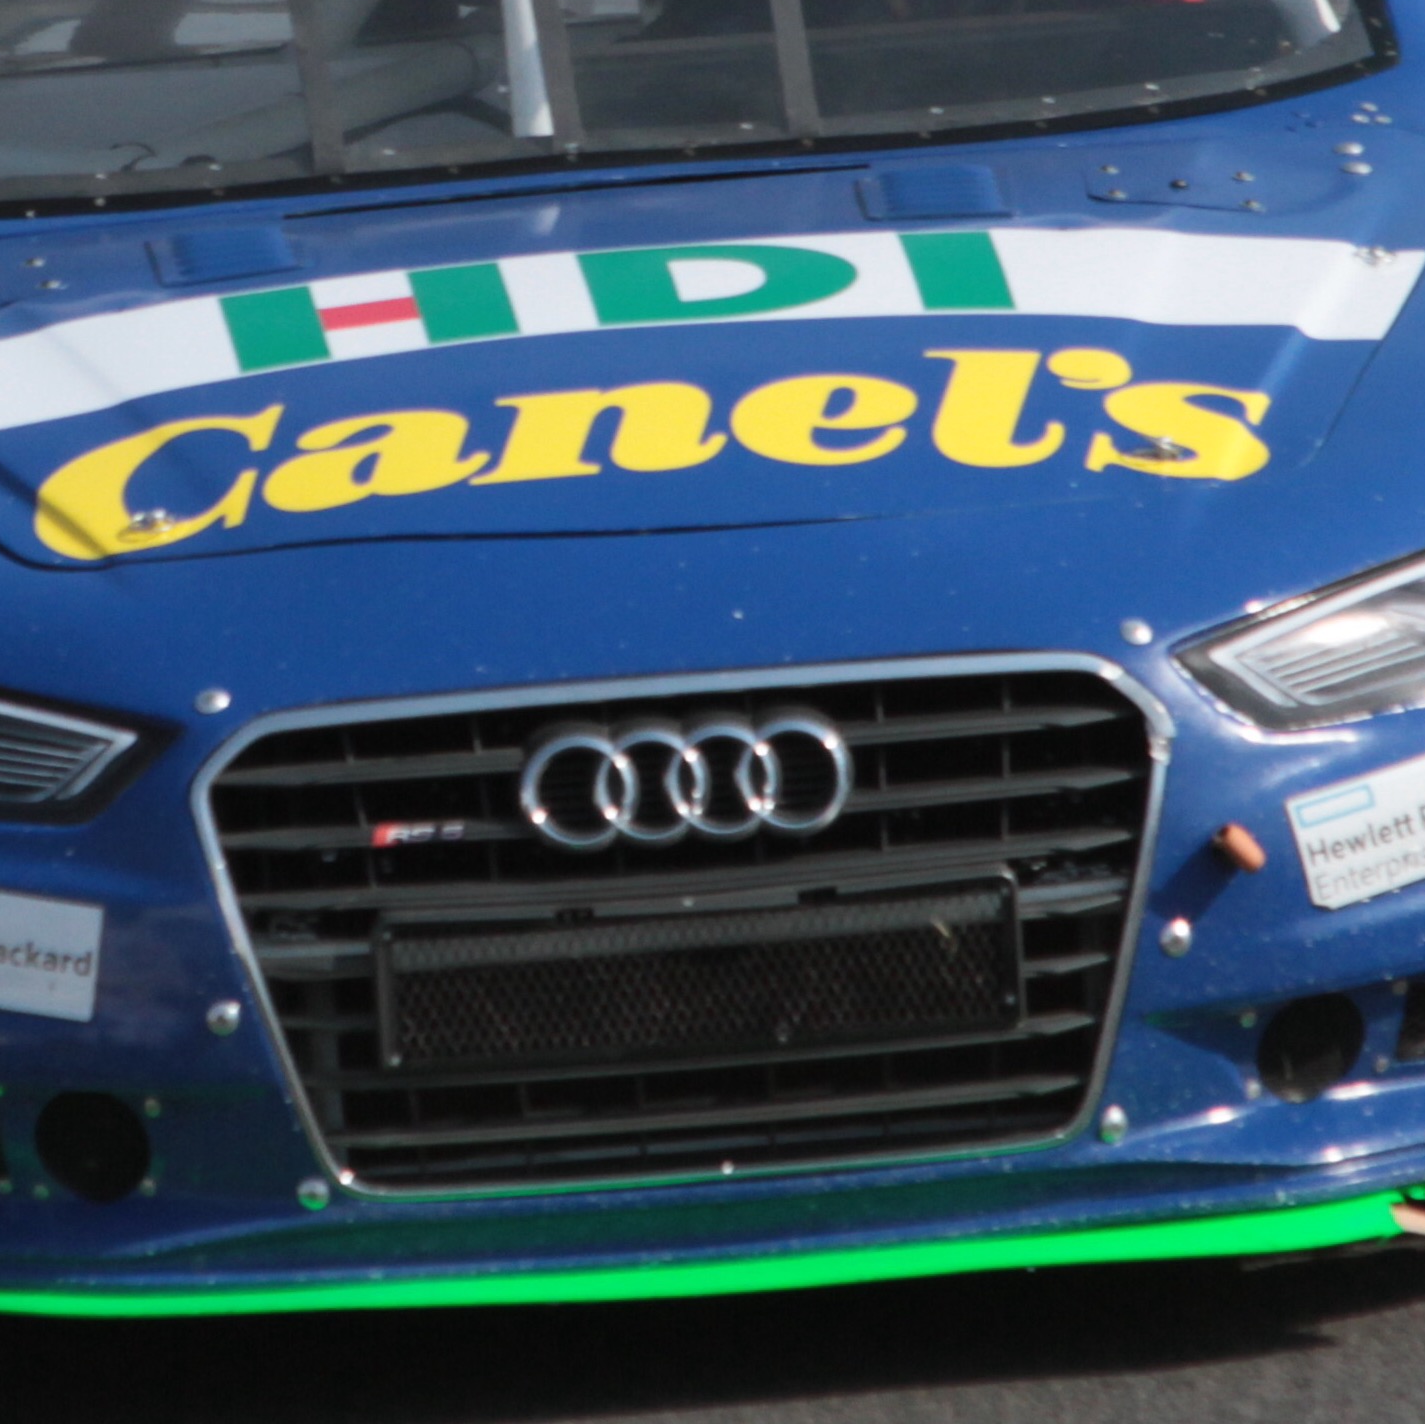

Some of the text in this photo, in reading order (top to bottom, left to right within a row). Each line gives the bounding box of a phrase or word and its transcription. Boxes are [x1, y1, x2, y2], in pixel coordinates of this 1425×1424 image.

[219, 230, 1016, 373] HDI
[34, 346, 1272, 560] Canel's
[1306, 812, 1416, 868] Hewlett
